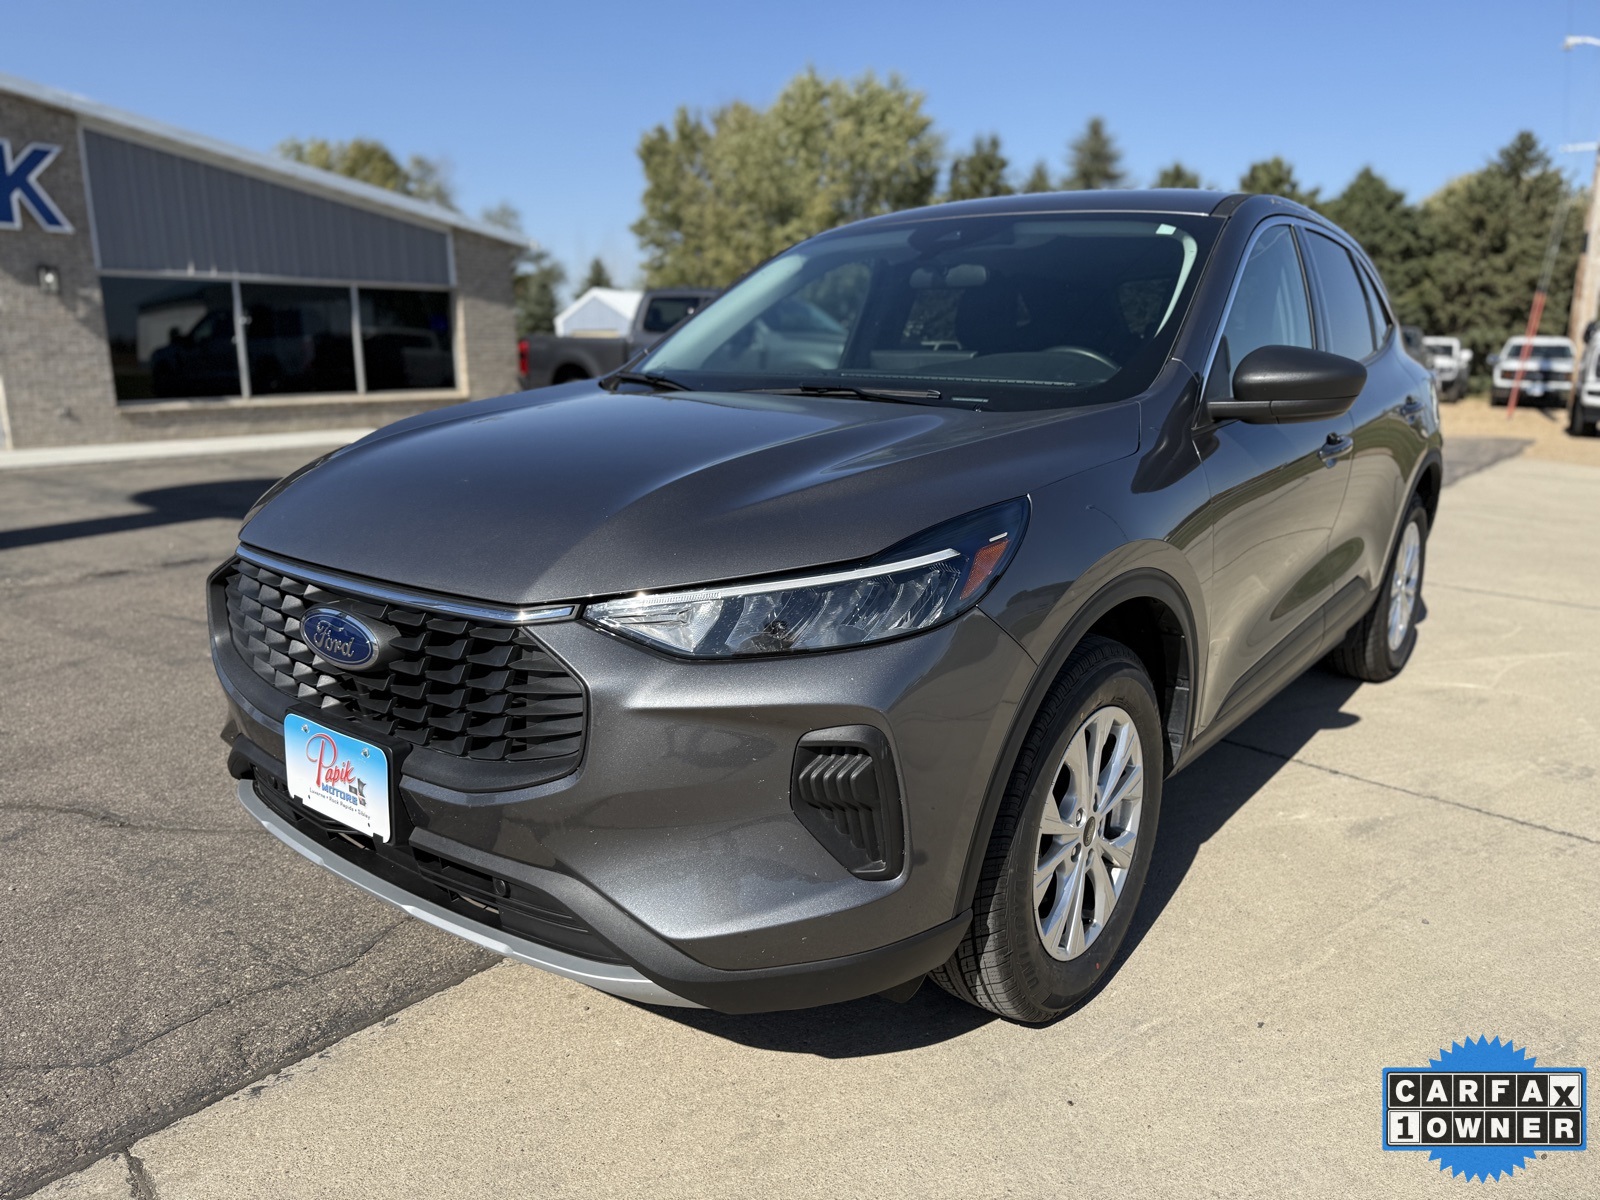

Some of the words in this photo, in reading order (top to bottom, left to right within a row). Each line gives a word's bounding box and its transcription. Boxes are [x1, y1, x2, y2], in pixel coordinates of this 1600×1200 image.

[313, 620, 355, 658] Ford
[306, 733, 355, 787] Papik
[321, 782, 358, 806] MOTORS
